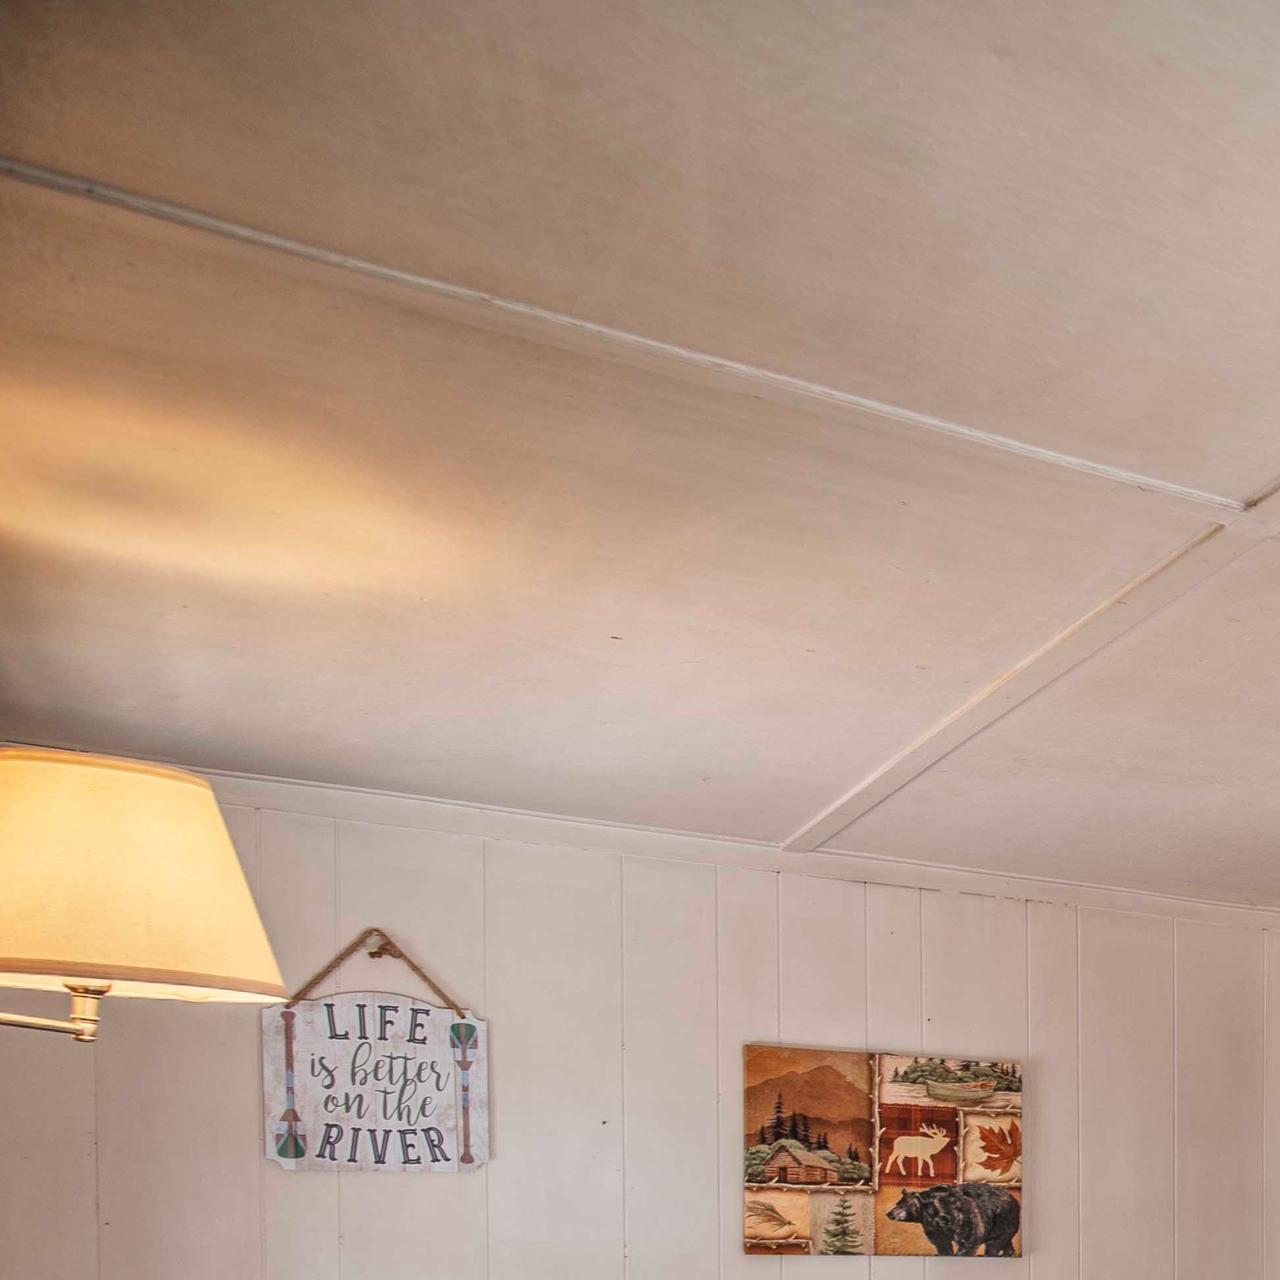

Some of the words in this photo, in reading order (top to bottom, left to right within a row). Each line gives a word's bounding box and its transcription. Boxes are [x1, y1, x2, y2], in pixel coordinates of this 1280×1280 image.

[323, 1003, 431, 1045] LIFE
[310, 1053, 338, 1089] is
[350, 1041, 450, 1091] better
[323, 1091, 370, 1120] on
[376, 1078, 438, 1127] the
[315, 1122, 452, 1165] RIVER
